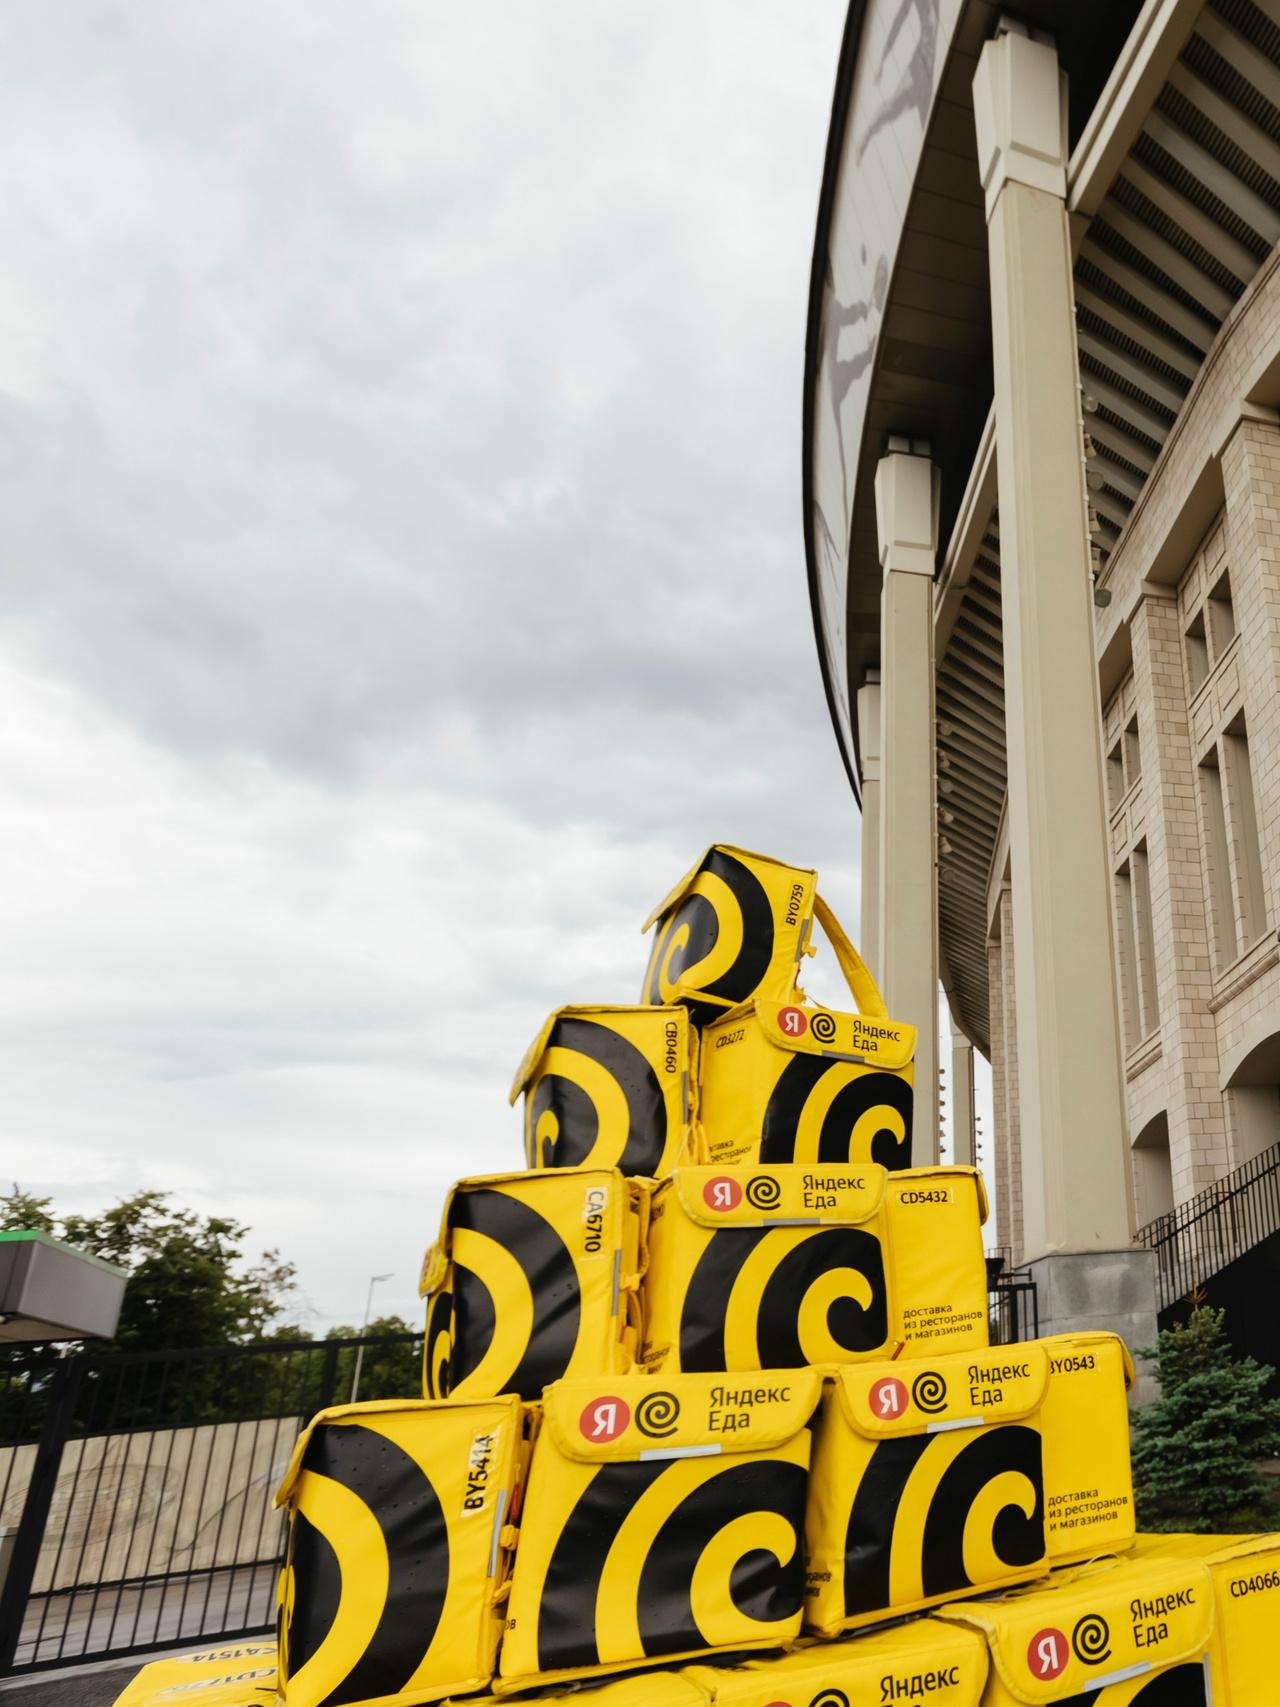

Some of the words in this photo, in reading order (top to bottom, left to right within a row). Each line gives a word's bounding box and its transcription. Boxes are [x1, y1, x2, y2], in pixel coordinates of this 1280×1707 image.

[785, 884, 804, 926] BY0759
[853, 1020, 901, 1042] Яндекс
[665, 1021, 678, 1074] CB0460
[853, 1035, 878, 1052] Еда
[803, 1175, 865, 1192] Яндекс
[803, 1193, 837, 1210] Еда
[900, 1190, 948, 1205] CD5432
[584, 1191, 604, 1253] CA6710
[903, 1304, 953, 1320] доставка
[904, 1320, 917, 1330] из
[920, 1311, 983, 1329] ресторанов
[905, 1333, 912, 1341] и
[914, 1323, 973, 1340] магазинов
[968, 1363, 1031, 1385] Яндекс
[709, 1387, 791, 1408] Яндекс
[970, 1387, 1003, 1407] Еда
[708, 1410, 750, 1432] Еда
[464, 1435, 494, 1510] BY5414
[1048, 1489, 1099, 1507] доставка
[1049, 1508, 1063, 1519] из
[1064, 1496, 1128, 1518] ресторанов
[1050, 1523, 1057, 1532] и
[1060, 1511, 1118, 1530] магазинов
[1230, 1570, 1280, 1598] CD4066
[1130, 1588, 1196, 1622] Яндекс
[1133, 1622, 1168, 1649] Еда
[880, 1666, 960, 1702] Яндекс
